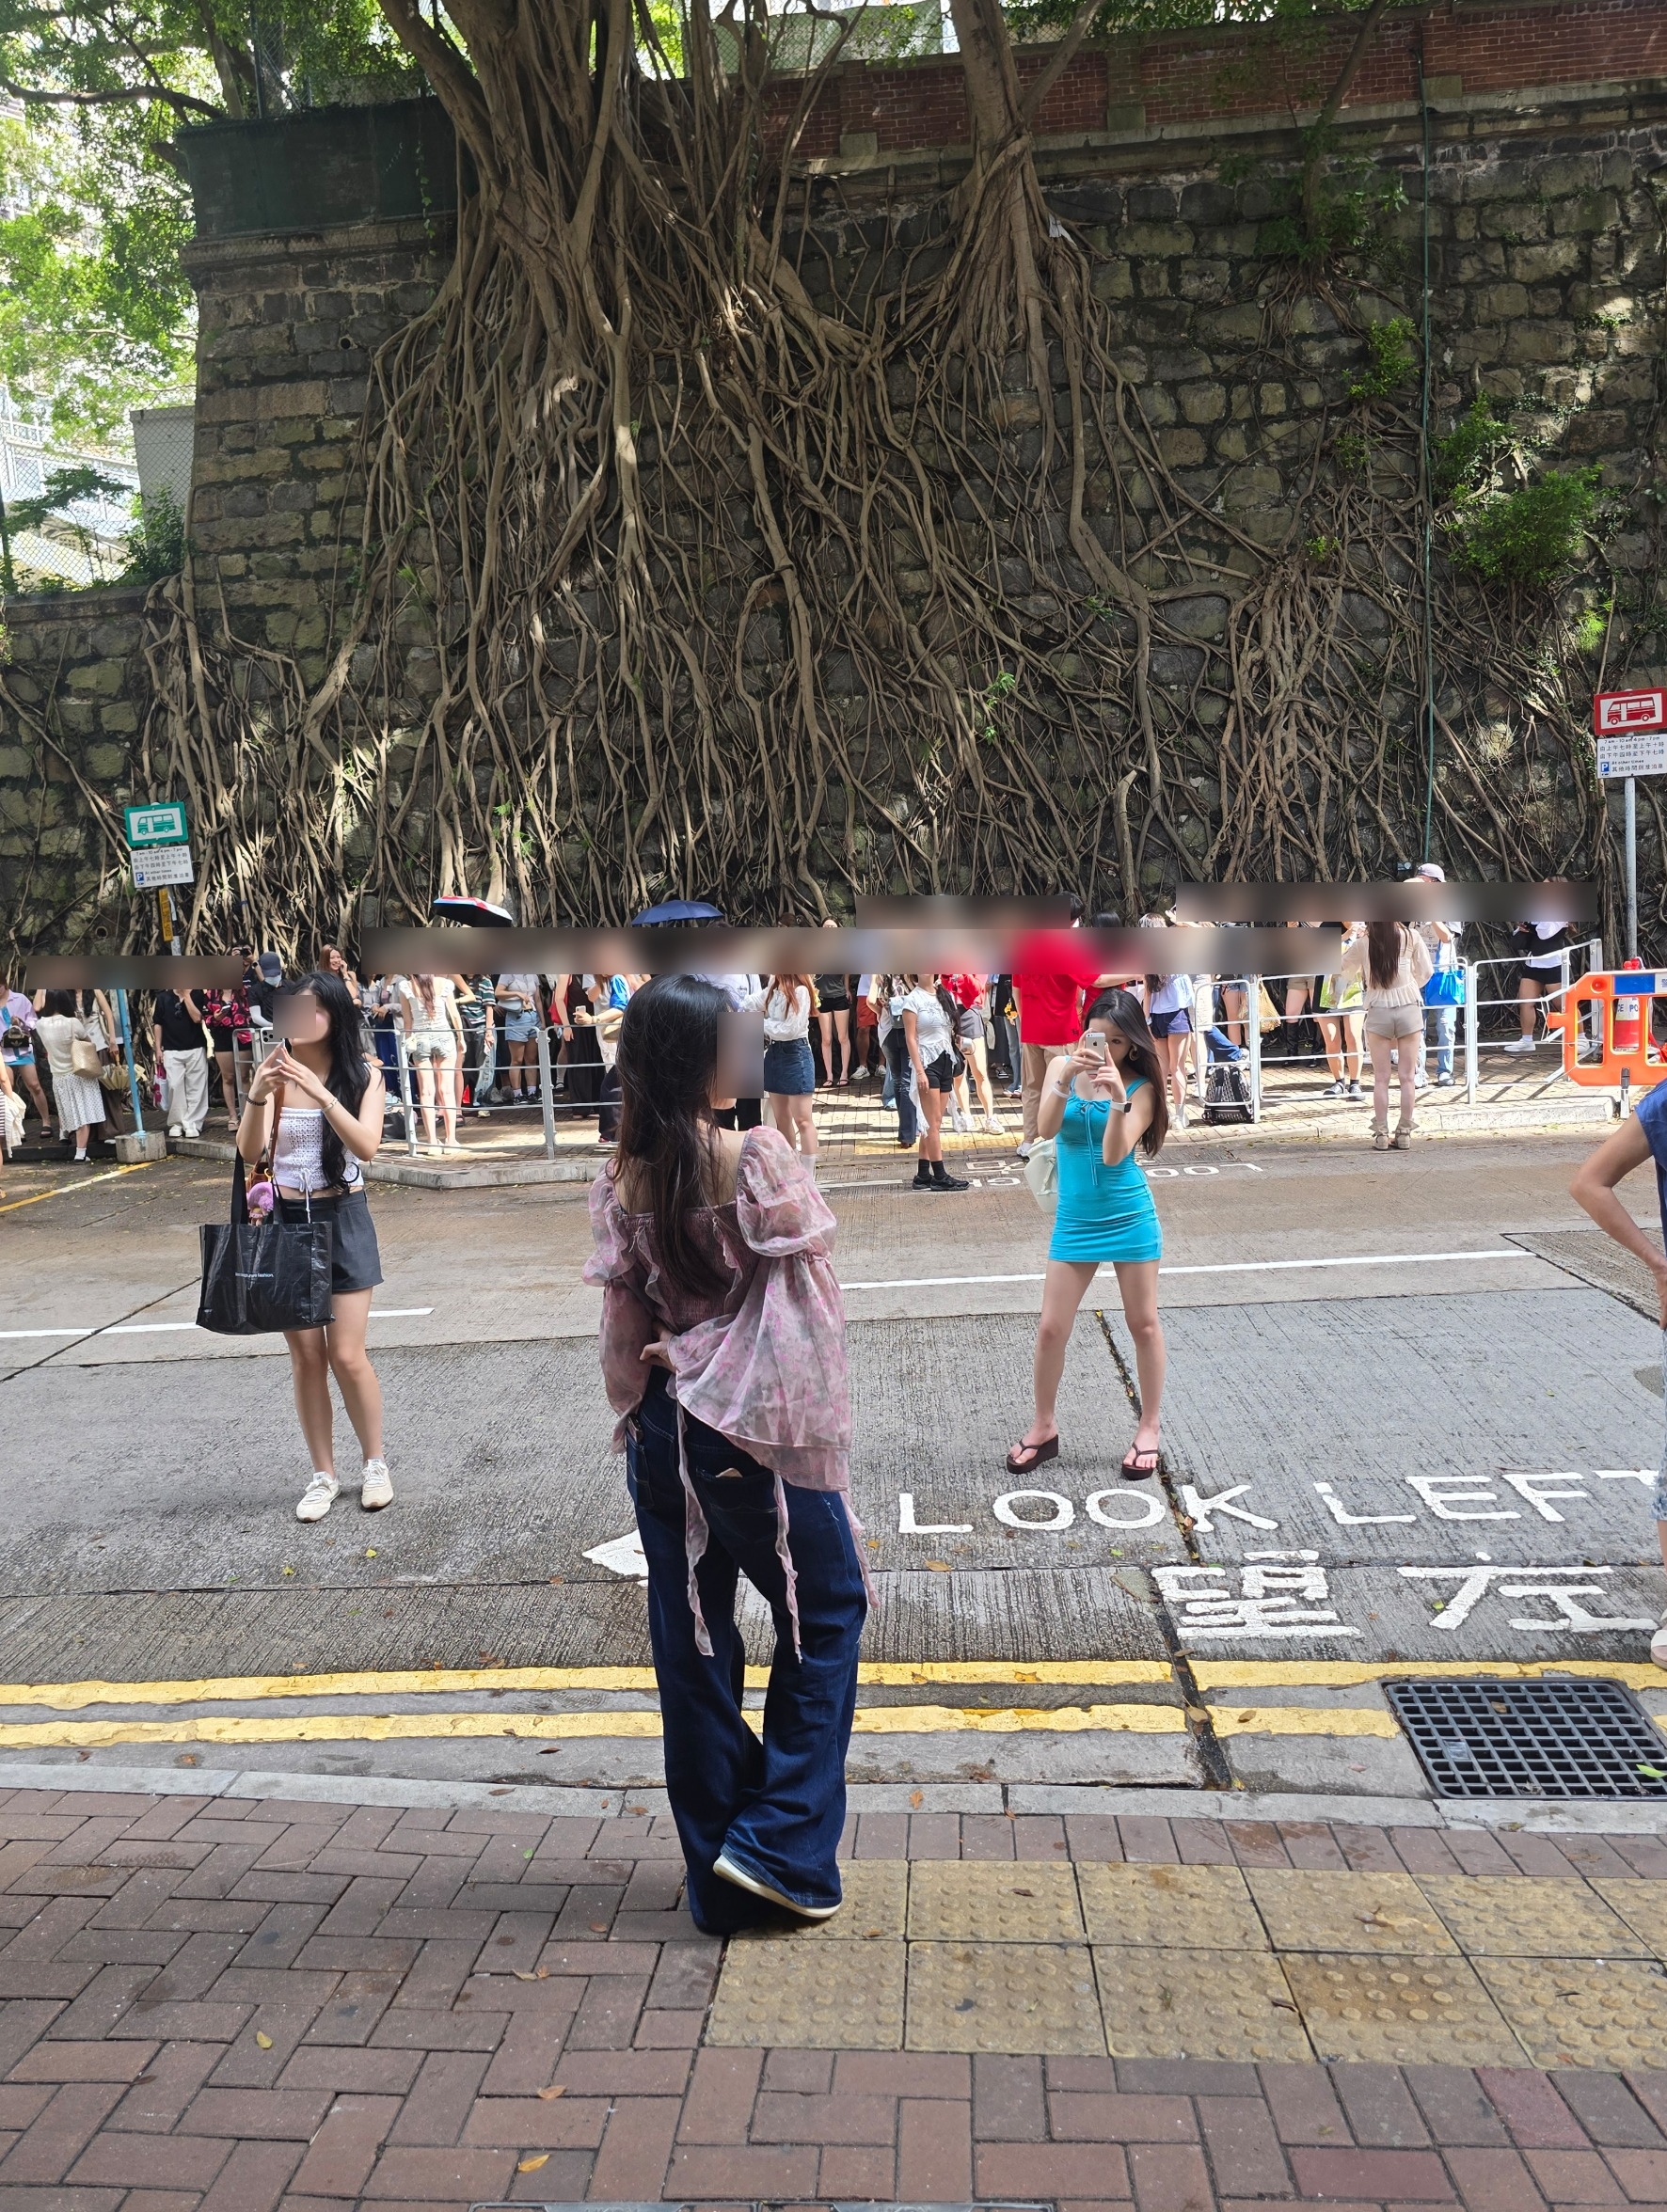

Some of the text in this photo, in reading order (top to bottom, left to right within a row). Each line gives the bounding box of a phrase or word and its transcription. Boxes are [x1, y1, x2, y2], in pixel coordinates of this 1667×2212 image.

[1144, 1162, 1264, 1178] LOO
[897, 1483, 1279, 1535] LOOK
[1151, 1549, 1659, 1639] 望左
